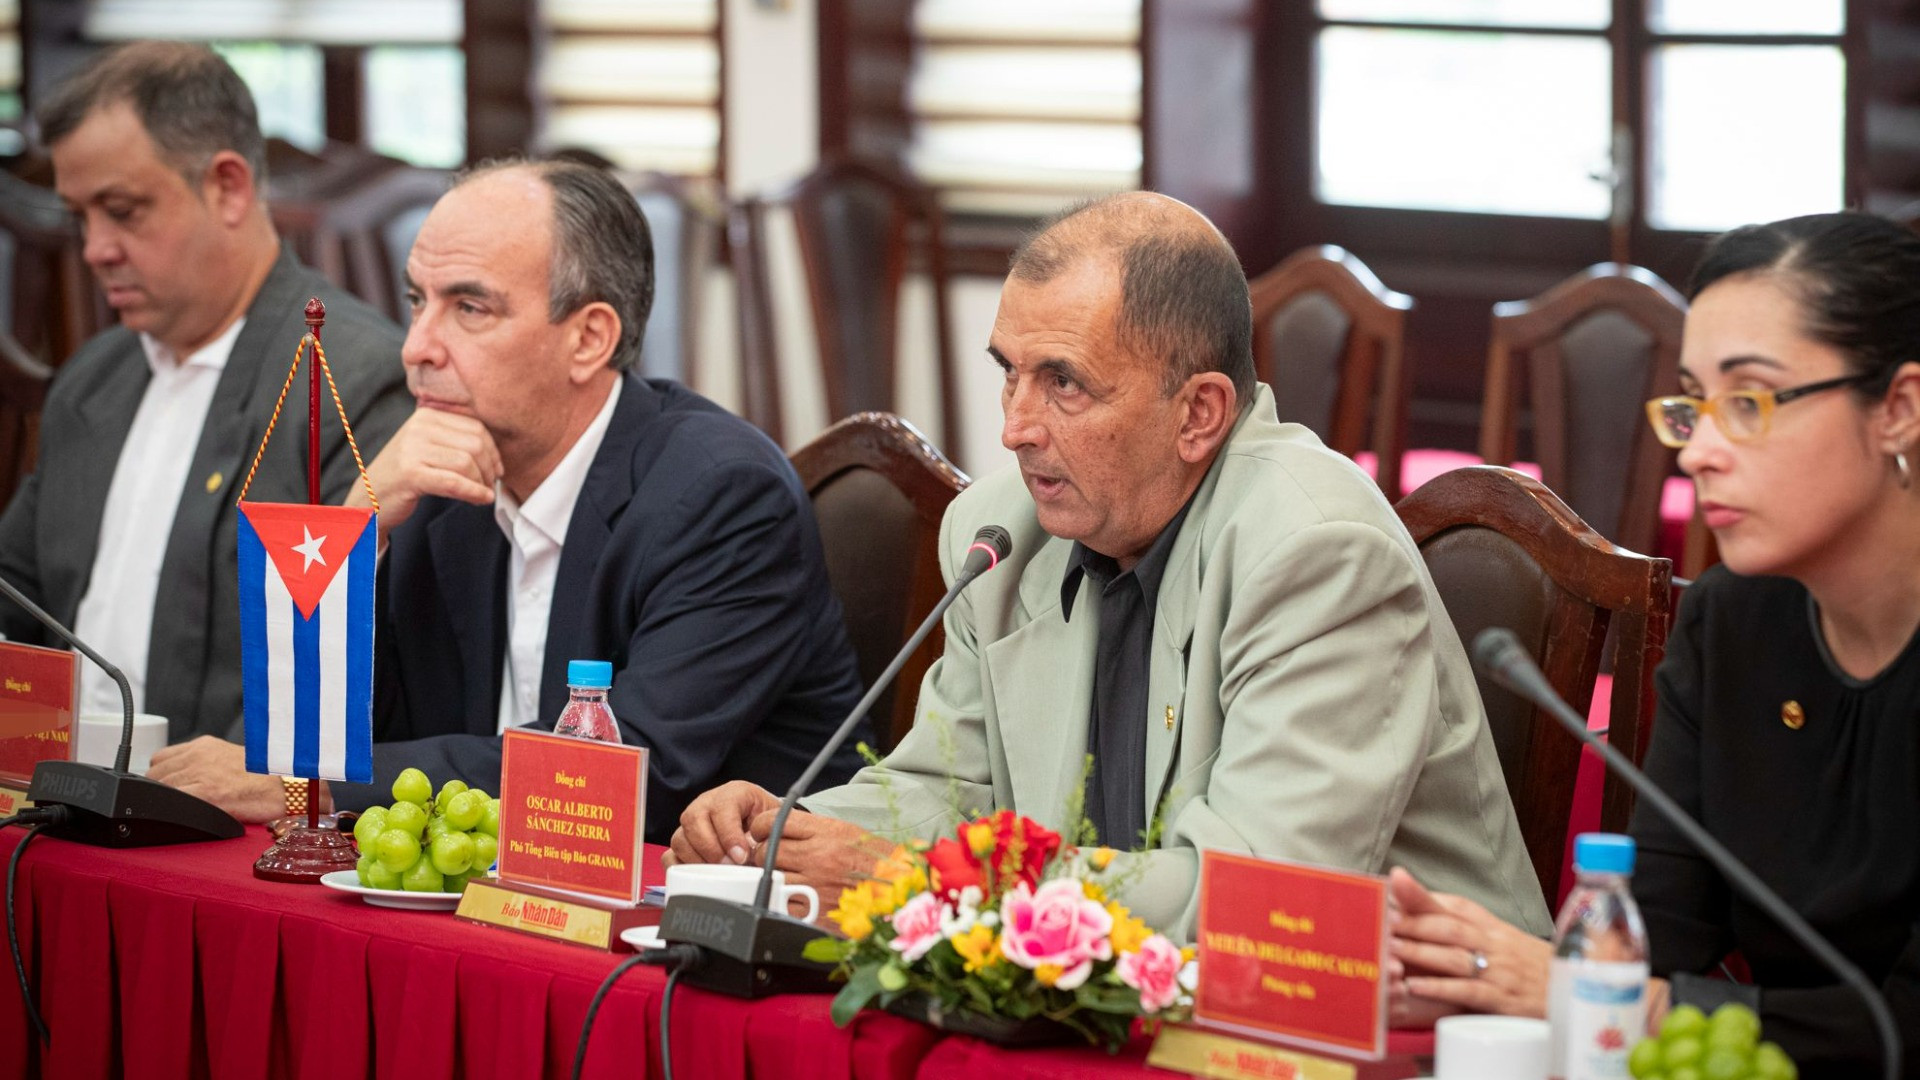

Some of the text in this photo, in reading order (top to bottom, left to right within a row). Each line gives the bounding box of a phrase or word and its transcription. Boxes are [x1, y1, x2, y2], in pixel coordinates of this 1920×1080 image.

[40, 772, 98, 800] PHILIPS
[575, 776, 587, 788] chí
[526, 795, 613, 822] OSCAR ALBERTO
[526, 812, 611, 842] SÁNCHEZ SERRA
[510, 839, 524, 854] Phó
[544, 845, 560, 860] Biên
[561, 848, 573, 864] tập
[573, 850, 587, 865] Báo
[588, 853, 625, 871] GRANMA
[671, 907, 736, 943] PHILIPS
